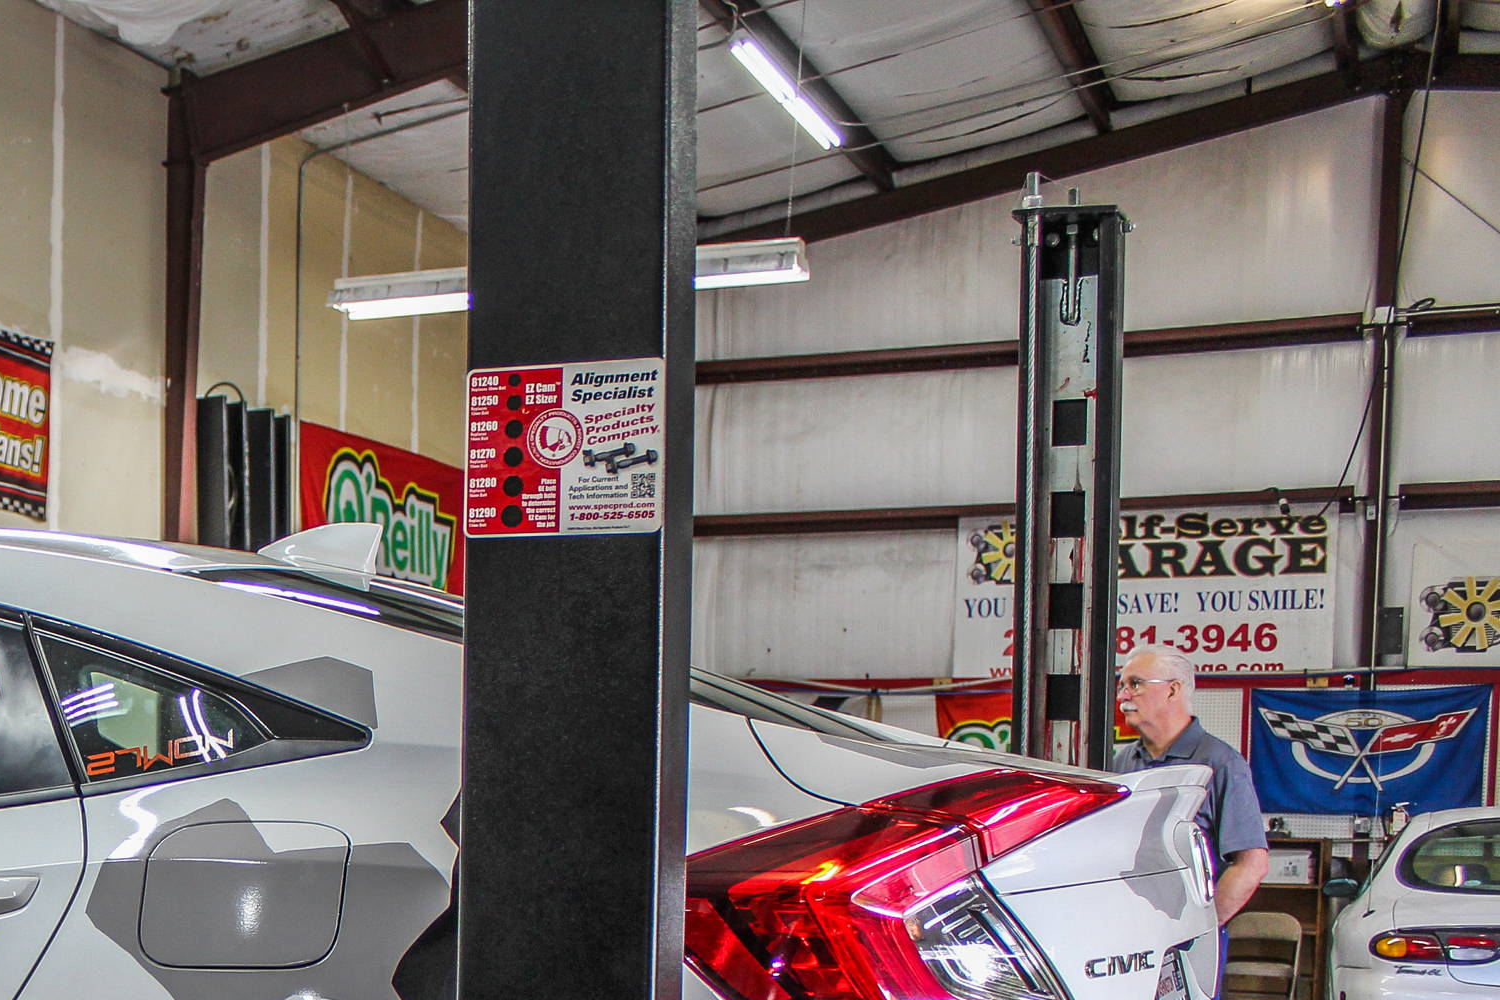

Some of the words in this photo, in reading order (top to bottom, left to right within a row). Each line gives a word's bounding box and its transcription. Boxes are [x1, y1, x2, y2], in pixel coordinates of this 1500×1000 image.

[471, 376, 499, 387] 81240
[571, 369, 658, 387] Alignment
[525, 383, 534, 393] EZ
[471, 395, 498, 406] 81250
[525, 394, 534, 404] EZ
[536, 394, 558, 404] Sizer
[571, 386, 654, 404] Specialist
[584, 403, 656, 424] Specialty
[470, 420, 498, 432] 81260
[586, 415, 654, 435] Products
[470, 448, 496, 460] 81270
[469, 477, 496, 488] 81280
[568, 484, 612, 493] Applications
[568, 502, 655, 510] www.specprod.com
[469, 508, 496, 518] 81290
[569, 510, 656, 520] 1-800-525-6505
[1119, 512, 1328, 540] lf-Serve
[1117, 536, 1328, 578] ARAGE
[964, 597, 1006, 618] YOU
[1117, 591, 1179, 614] SAVE!
[1197, 589, 1242, 612] YOU
[1247, 588, 1325, 611] SMILE!
[1346, 717, 1383, 728] 50
[1085, 950, 1155, 979] CIVIC
